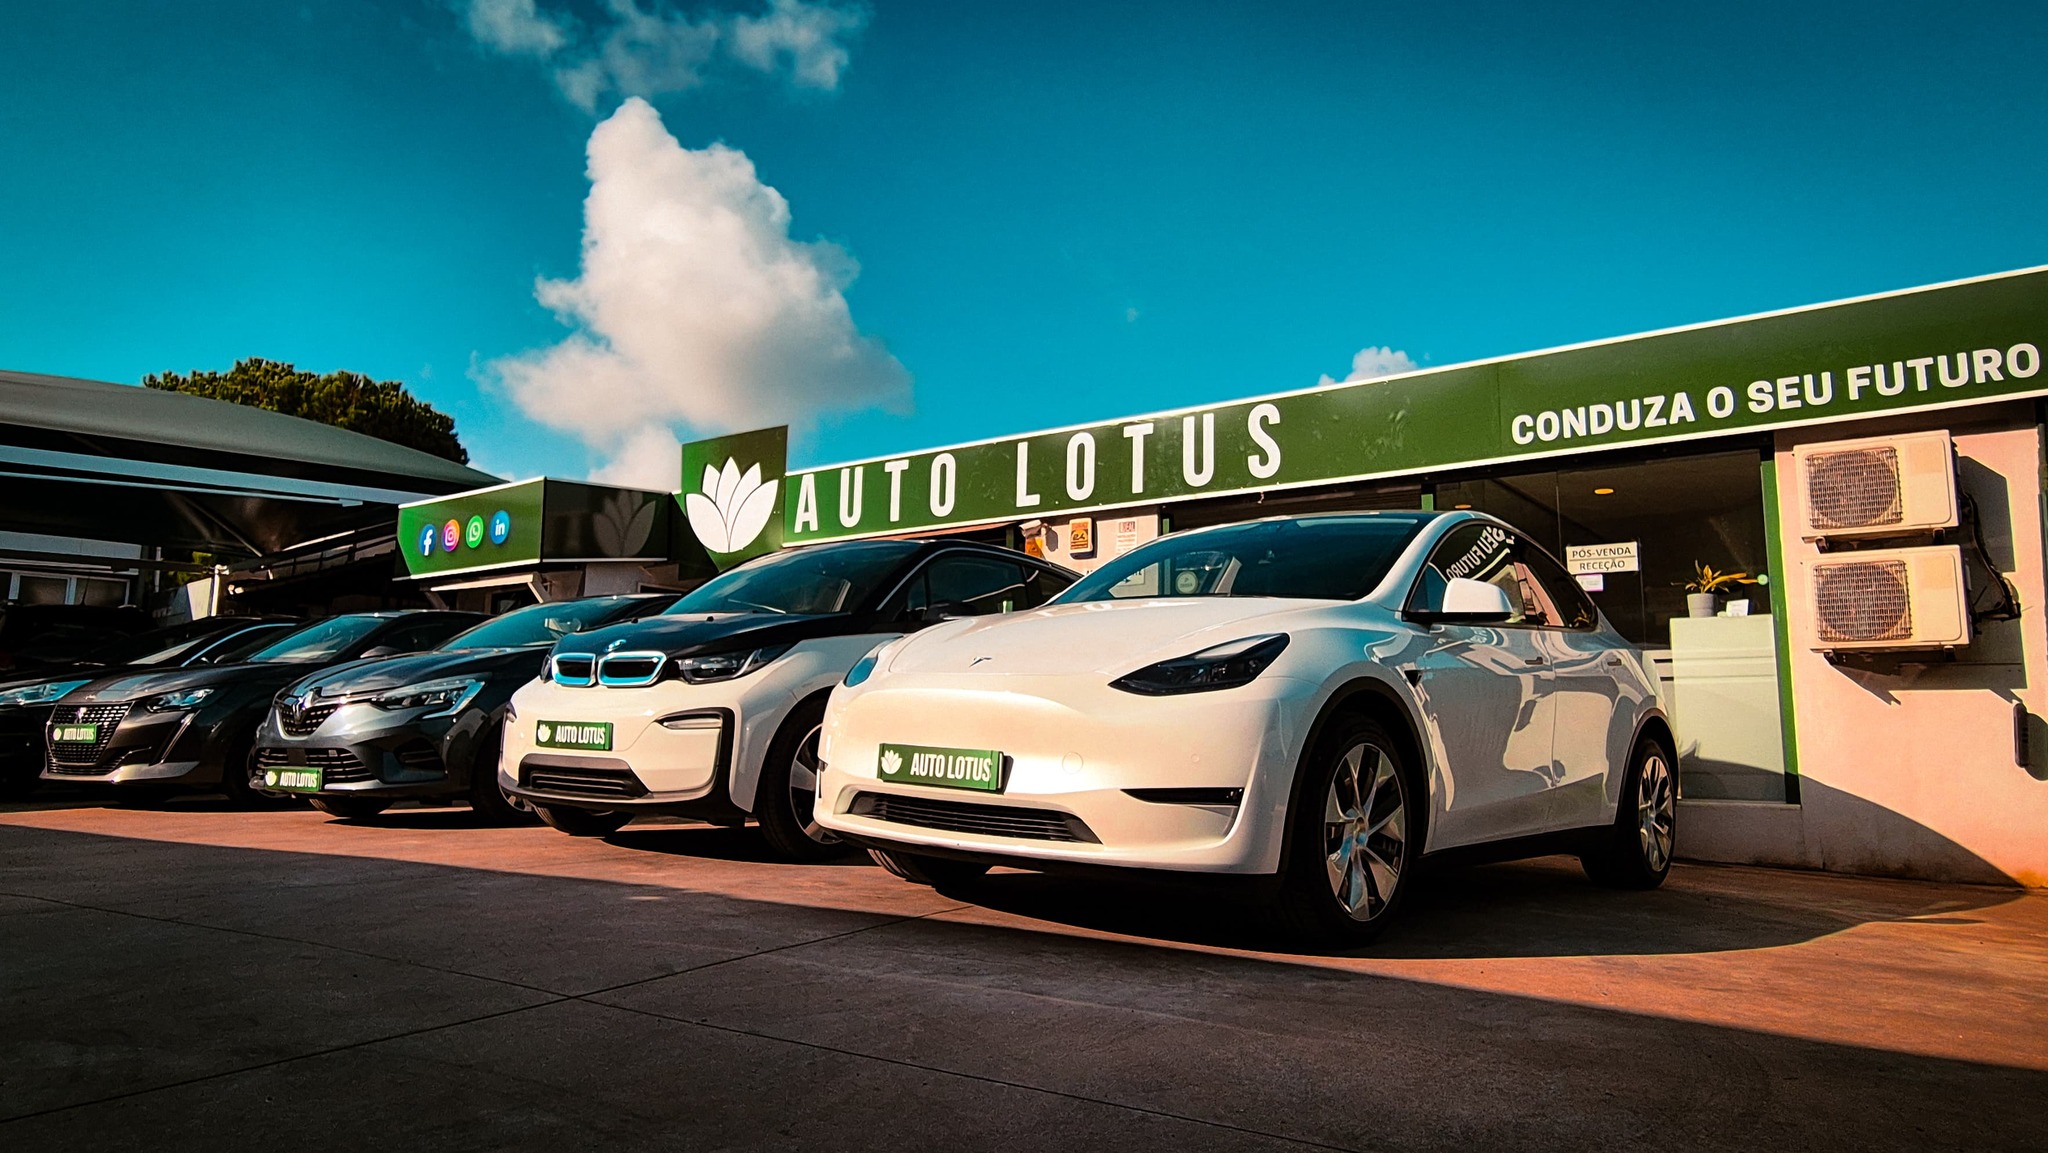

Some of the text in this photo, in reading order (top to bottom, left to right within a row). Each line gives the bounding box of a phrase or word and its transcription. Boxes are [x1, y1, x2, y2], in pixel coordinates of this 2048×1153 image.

[1511, 343, 2041, 445] CONDUZA O SEU FUTURO
[794, 403, 1281, 534] AUTO LOTUS
[1572, 542, 1632, 558] PÓS-VENDA
[1579, 558, 1626, 571] RECEÇÃO
[63, 728, 94, 740] AUTO LOTUS
[555, 725, 605, 745] AUTO LOTUS
[910, 753, 993, 782] AUTO LOTUS
[280, 771, 317, 788] AUTO LOTUS
